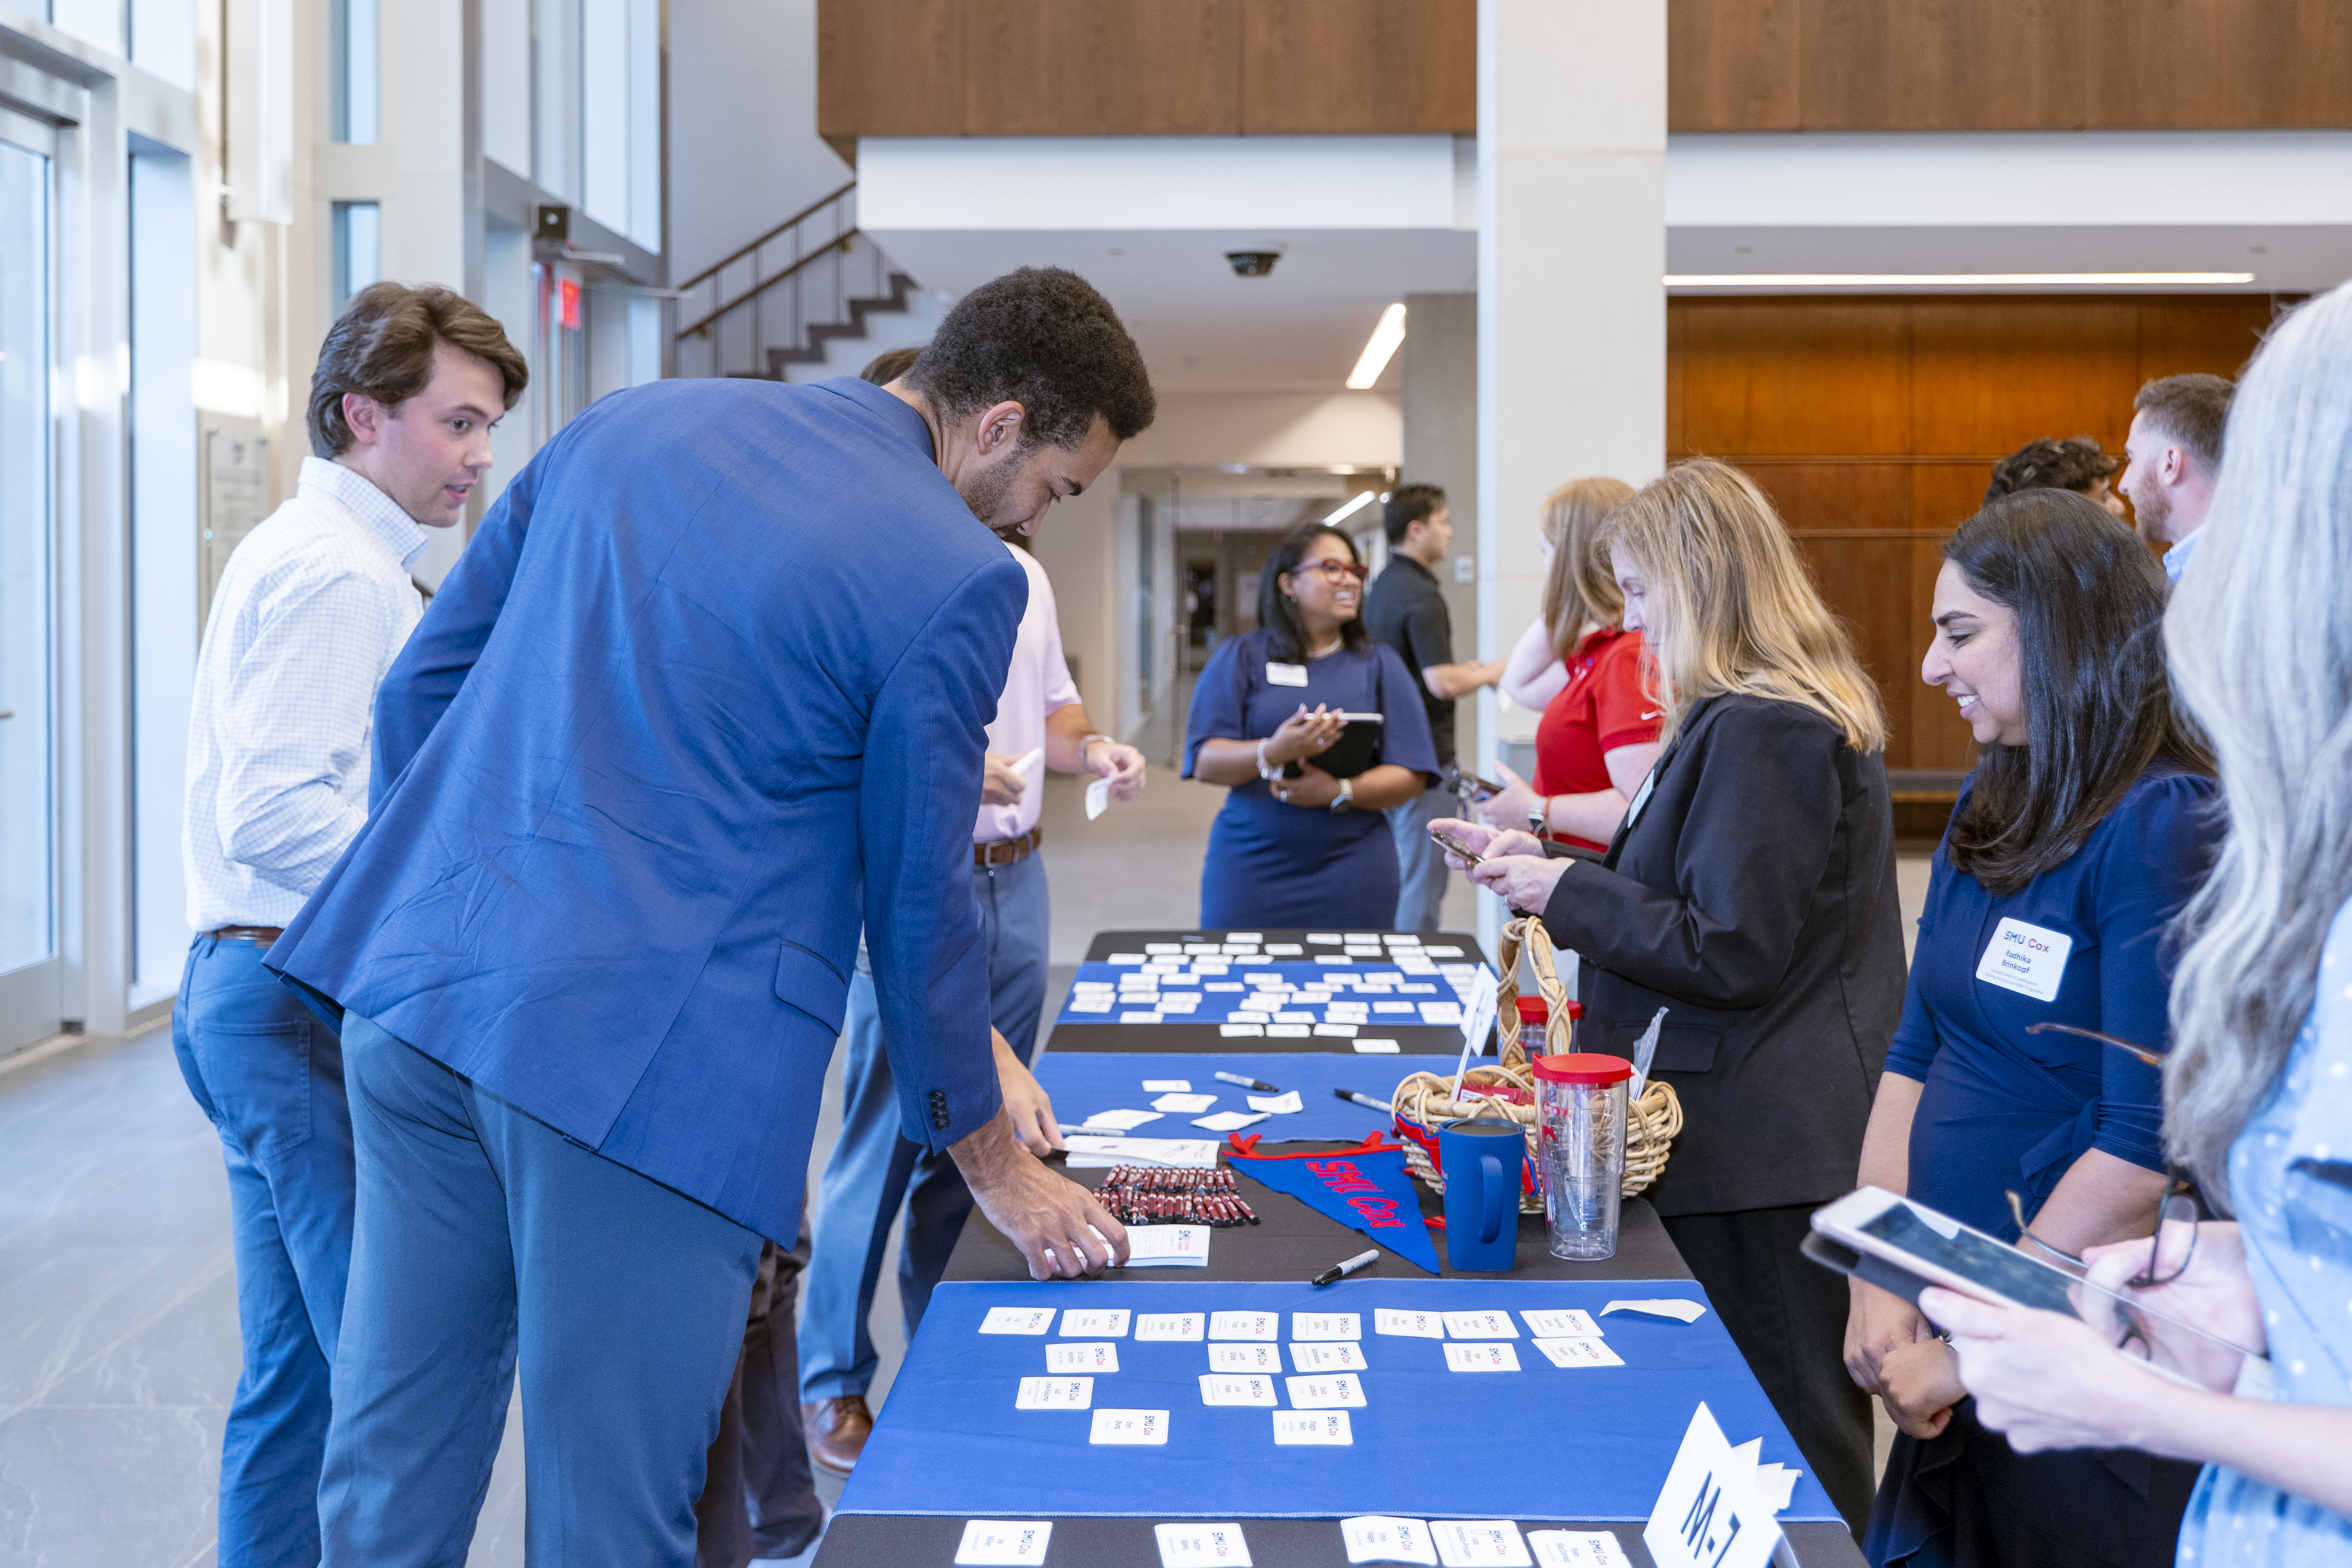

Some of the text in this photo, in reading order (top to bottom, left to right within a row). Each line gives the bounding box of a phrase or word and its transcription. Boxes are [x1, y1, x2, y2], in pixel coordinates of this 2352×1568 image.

[2004, 931, 2049, 953] SMU Cox
[2005, 950, 2031, 964] Radhika
[2001, 959, 2031, 974] Brinkopf
[1996, 976, 2014, 986] Professional
[2025, 985, 2043, 995] Programs
[2016, 977, 2038, 987] Admissions
[1542, 1100, 1570, 1117] Cox
[1305, 1161, 1406, 1228] SMU Cox
[1179, 1230, 1191, 1240] SMU
[1031, 1313, 1043, 1321] SMU
[1110, 1314, 1119, 1323] SMU
[1417, 1316, 1426, 1324] SMU
[1485, 1316, 1497, 1325] SMU
[1566, 1315, 1579, 1323] SMU
[1183, 1318, 1192, 1327] SMU
[1256, 1318, 1265, 1327] SMU
[1095, 1348, 1105, 1357] SMU
[1256, 1348, 1267, 1357] SMU
[1338, 1347, 1349, 1356] SMU
[1489, 1348, 1500, 1357] SMU
[1579, 1343, 1595, 1352] SMU
[1070, 1383, 1080, 1392] SMU
[1250, 1381, 1261, 1390] SMU
[1336, 1381, 1348, 1390] SMU
[1113, 1420, 1123, 1429] Zhang
[1143, 1416, 1154, 1436] SMU Cox
[1308, 1421, 1317, 1431] Maggie
[1327, 1417, 1338, 1426] SMU
[985, 1536, 995, 1546] Miller
[1018, 1530, 1035, 1554] SMU Cox
[1366, 1532, 1375, 1543] Magee
[1379, 1532, 1388, 1542] Emily
[1397, 1526, 1413, 1550] SMU Cox
[1455, 1526, 1474, 1558] Machado-Prosperi
[1181, 1539, 1189, 1550] Marks
[1193, 1539, 1201, 1550] Paxton
[1212, 1532, 1228, 1556] SMU Cox
[1495, 1545, 1507, 1555] Cox
[1556, 1542, 1572, 1563] MacDonald
[1571, 1548, 1580, 1556] Ryan
[1588, 1540, 1608, 1565] SMU Cox
